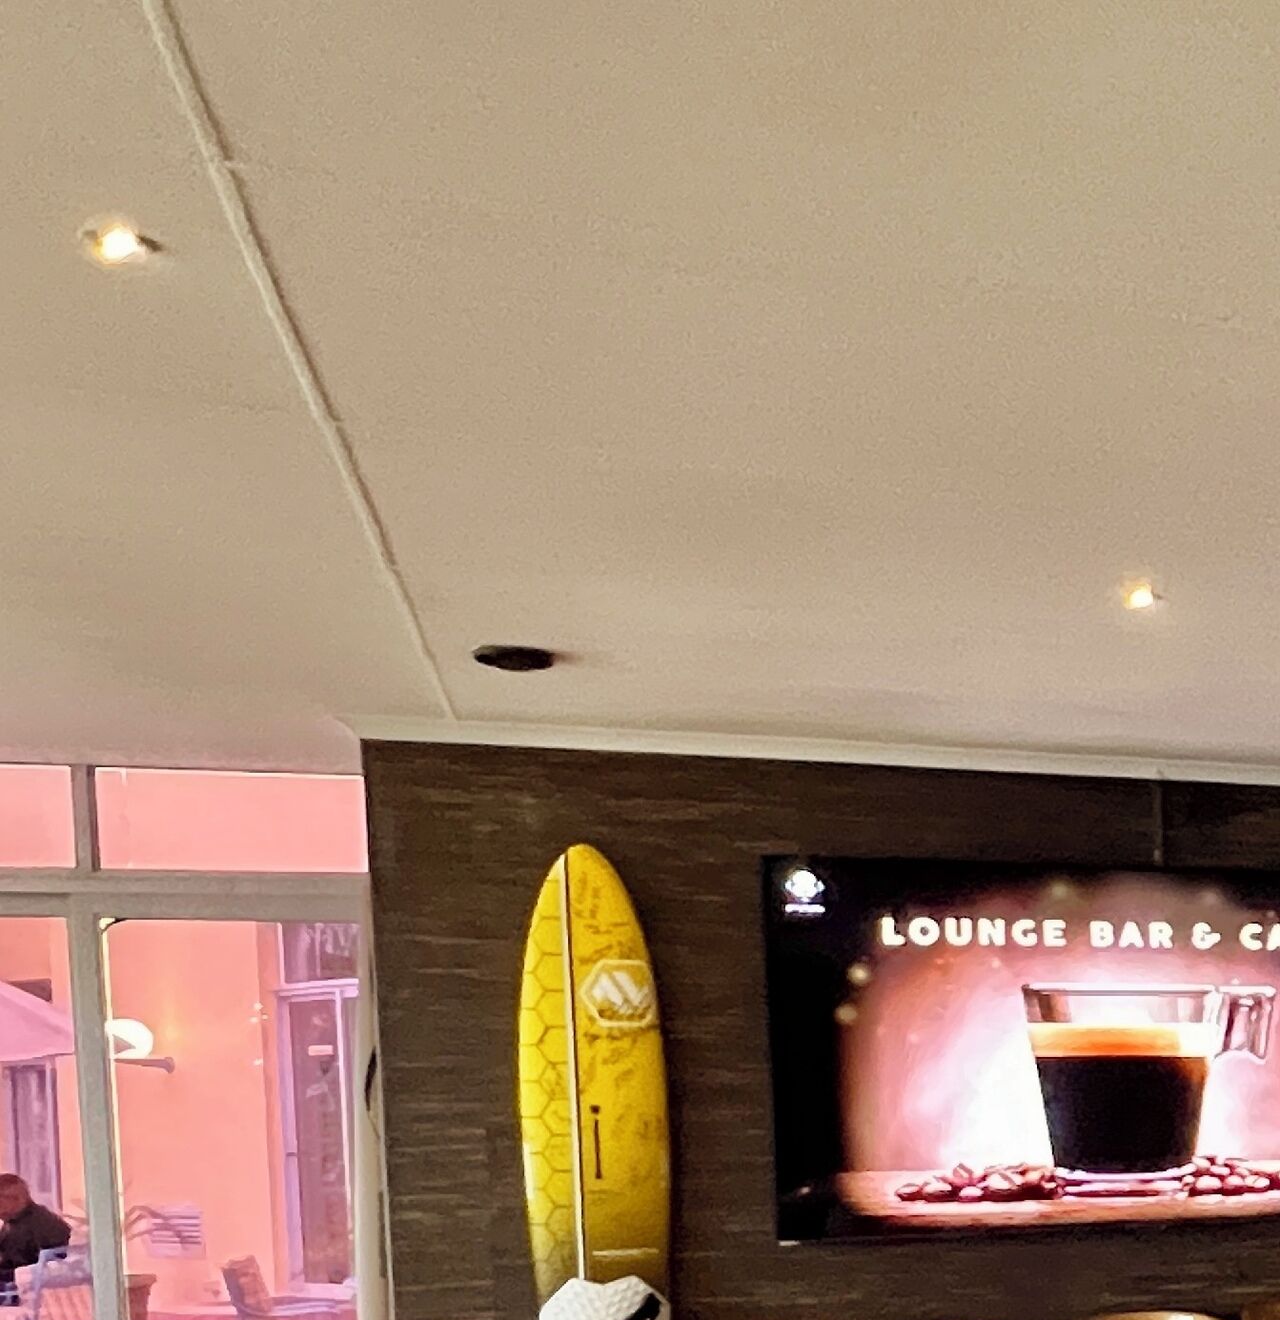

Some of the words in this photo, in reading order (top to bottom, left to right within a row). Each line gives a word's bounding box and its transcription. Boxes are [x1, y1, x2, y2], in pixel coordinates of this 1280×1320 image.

[880, 916, 1068, 948] LOUNGE
[1089, 920, 1175, 950] BAR
[1190, 922, 1222, 951] &
